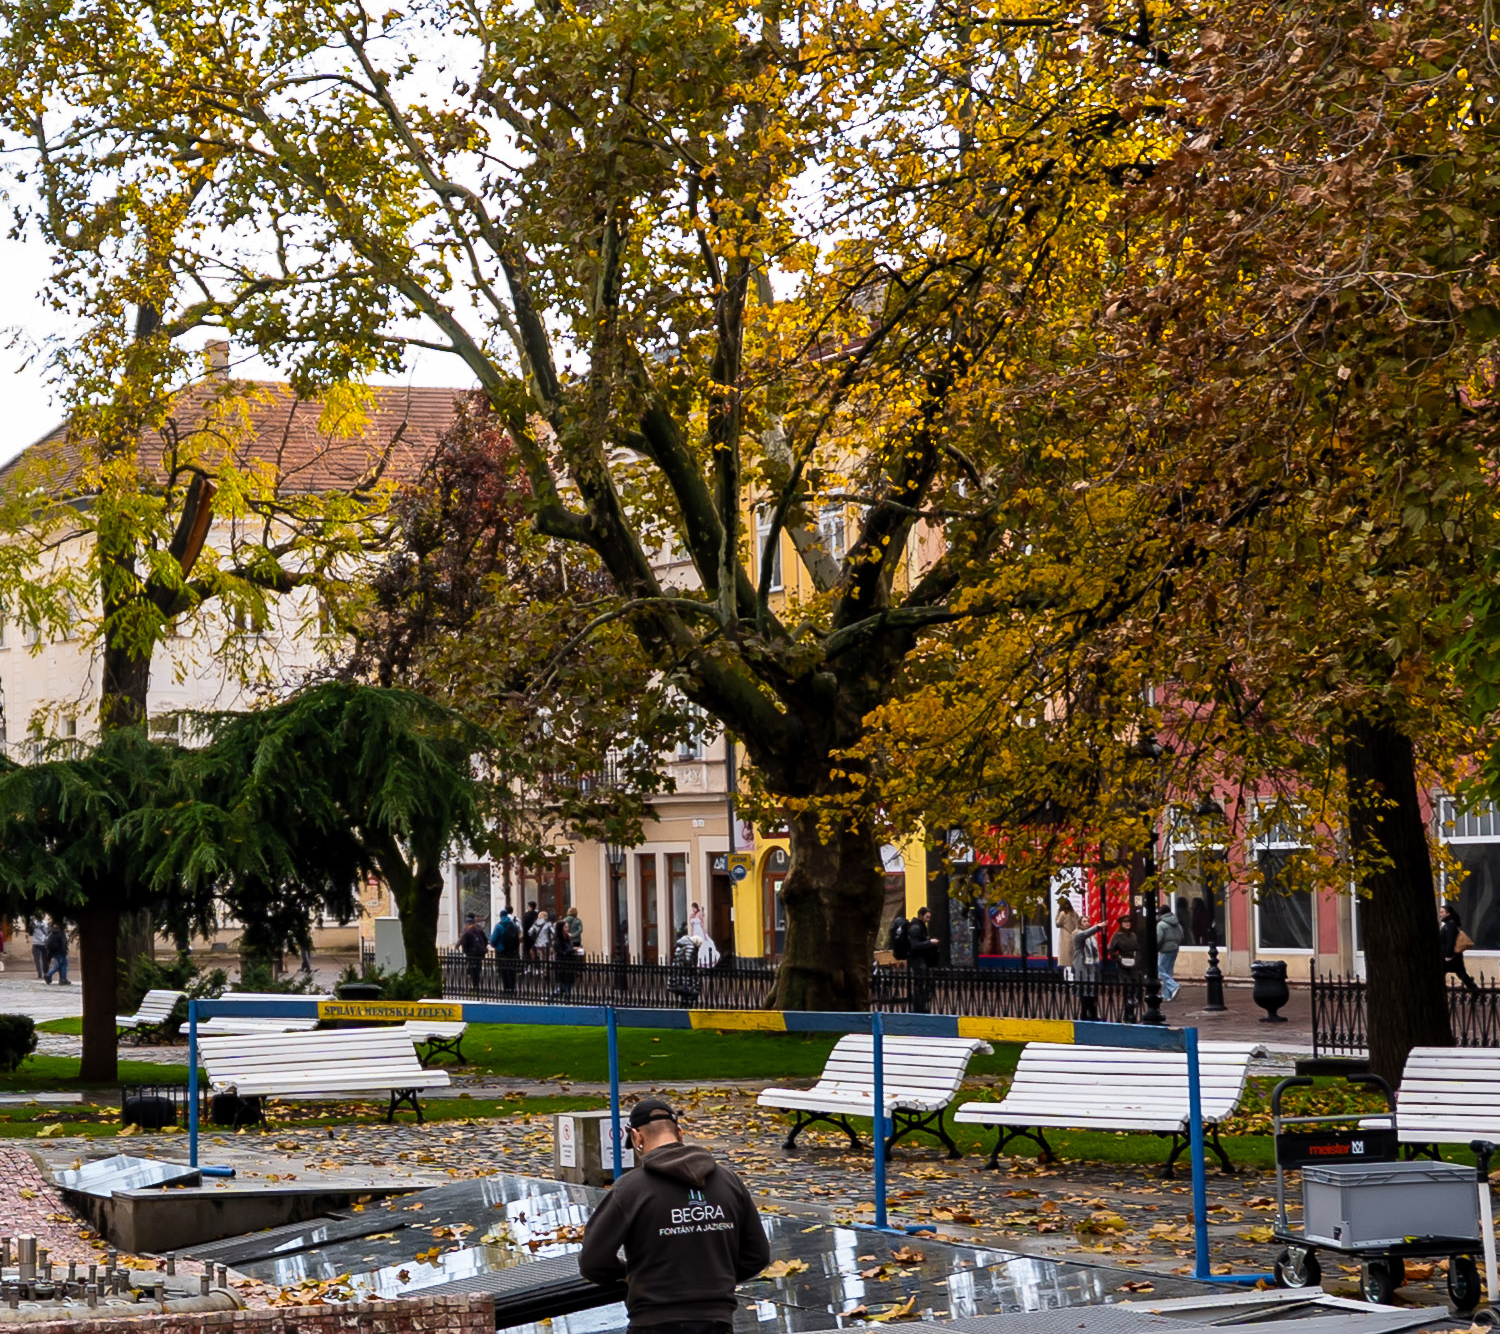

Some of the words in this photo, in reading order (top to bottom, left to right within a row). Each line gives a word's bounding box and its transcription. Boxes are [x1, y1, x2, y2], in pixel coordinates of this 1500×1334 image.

[324, 1004, 362, 1016] SPRÁVA
[365, 1006, 414, 1017] MESTSKEJ
[417, 1007, 454, 1018] ZELENE
[1309, 1142, 1350, 1155] meister
[671, 1205, 725, 1224] BEGRA
